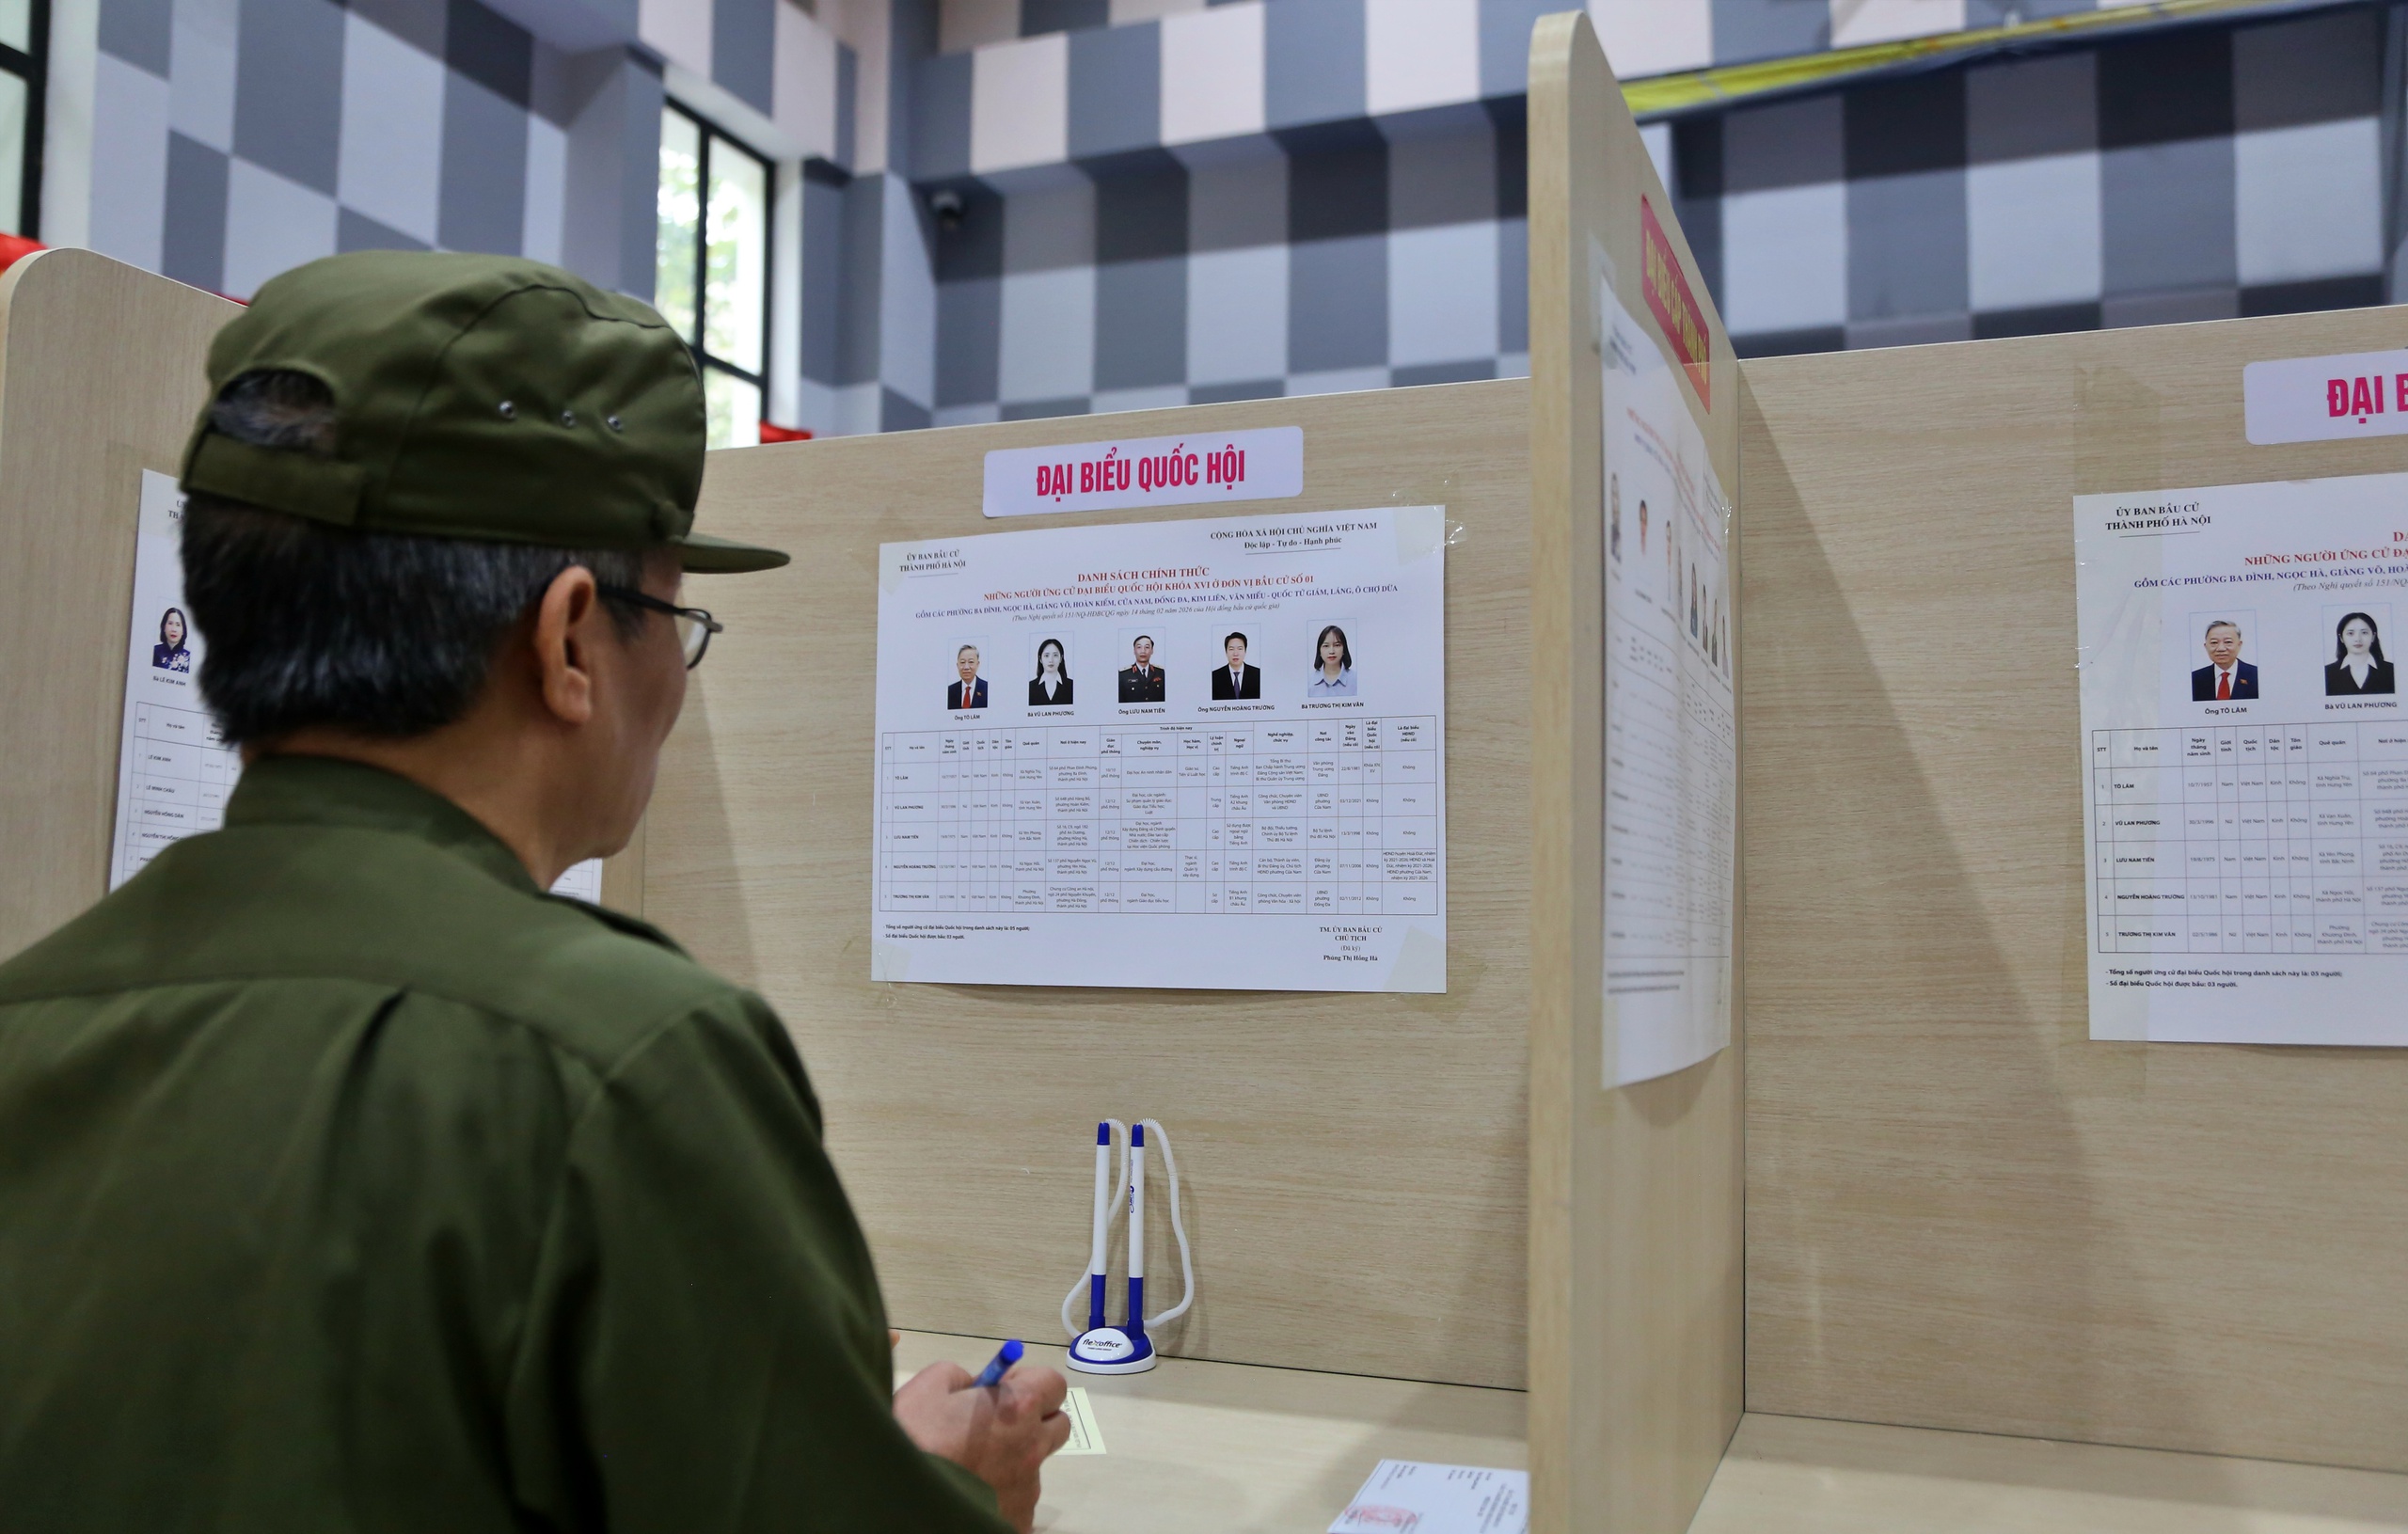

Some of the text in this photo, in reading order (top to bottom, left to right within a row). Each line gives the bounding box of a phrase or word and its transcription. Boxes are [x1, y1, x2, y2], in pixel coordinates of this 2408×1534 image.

[2327, 375, 2384, 424] ĐẠI
[1036, 443, 1245, 502] ĐẠI BIỂU QUỐC HỘI
[2116, 501, 2199, 517] ỦY BAN BẦU CỬ
[2104, 514, 2210, 530] THÀNH PHỐ HÀ NỘI
[1210, 530, 1234, 541] CỘNG
[1235, 529, 1254, 538] HÒA
[1255, 528, 1267, 537] XÃ
[1269, 527, 1285, 537] HỘI
[1286, 525, 1305, 535] CHỦ
[1307, 524, 1334, 533] NGHĨA
[1336, 523, 1356, 532] VIỆT
[2244, 546, 2408, 565] NHỮNG NGƯỜI ỨNG CỬ ĐẠ
[1078, 565, 1210, 582] DANH SÁCH CHÍNH THỨC
[2134, 577, 2159, 588] GỒM
[2161, 577, 2181, 587] CÁC
[2184, 575, 2226, 585] PHƯỜNG
[2229, 575, 2243, 583] BA
[2245, 572, 2274, 581] ĐÌNH,
[2276, 571, 2307, 580] NGỌC
[2309, 569, 2328, 577] HÀ,
[2330, 566, 2365, 577] GIẢNG
[2368, 564, 2385, 575] VÕ,
[984, 574, 1313, 601] NHỮNG NGƯỜI ỨNG CỬ ĐẠI BIỂU QUỐC HỘI KHÓA XVI Ở ĐƠN VỊ BẦU CỬ SỐ 01
